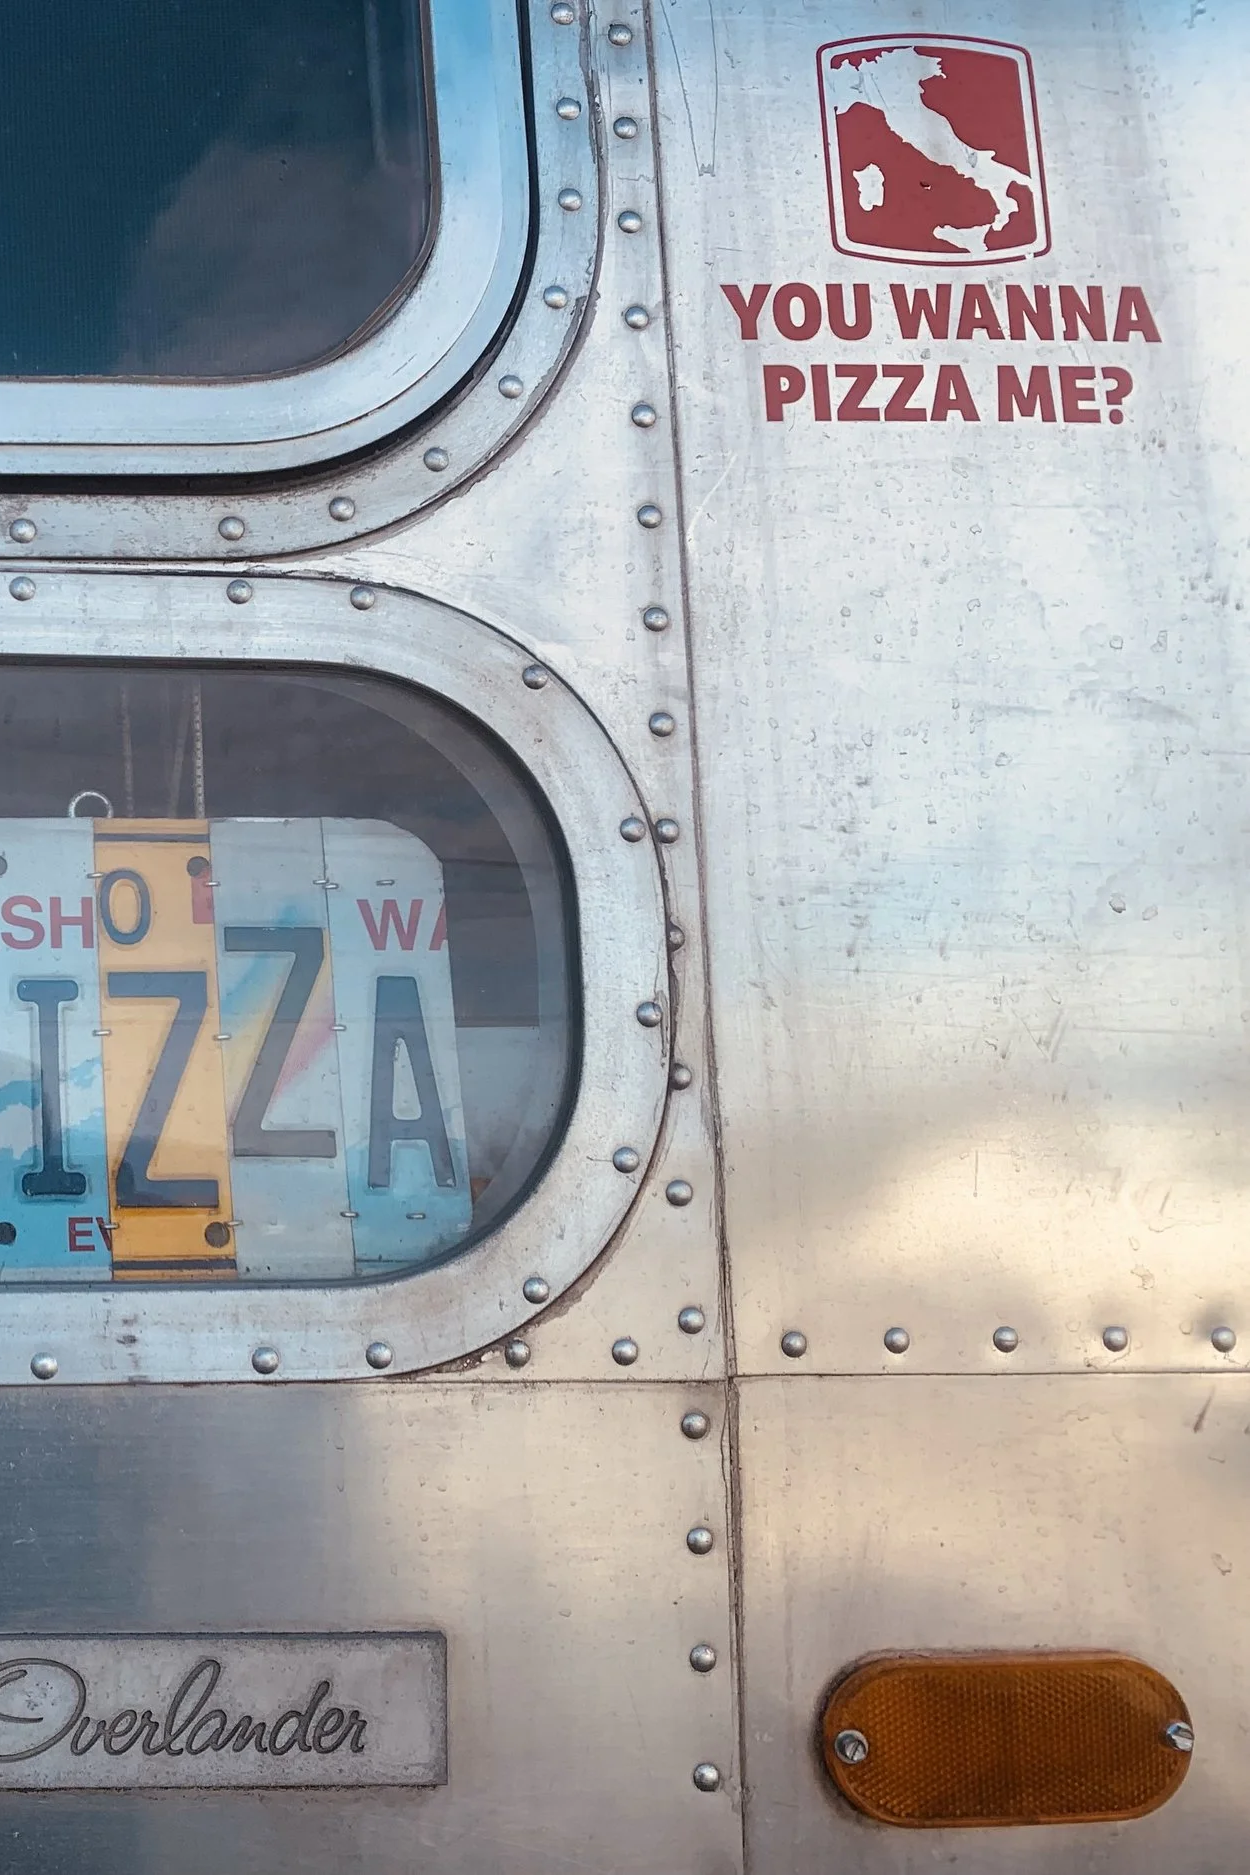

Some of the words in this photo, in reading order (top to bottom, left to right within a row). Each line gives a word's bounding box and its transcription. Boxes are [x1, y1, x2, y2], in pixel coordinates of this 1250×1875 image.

[720, 282, 872, 341] YOU
[889, 282, 1162, 343] WANNA
[763, 364, 981, 422] PIZZA
[997, 365, 1134, 425] ME?
